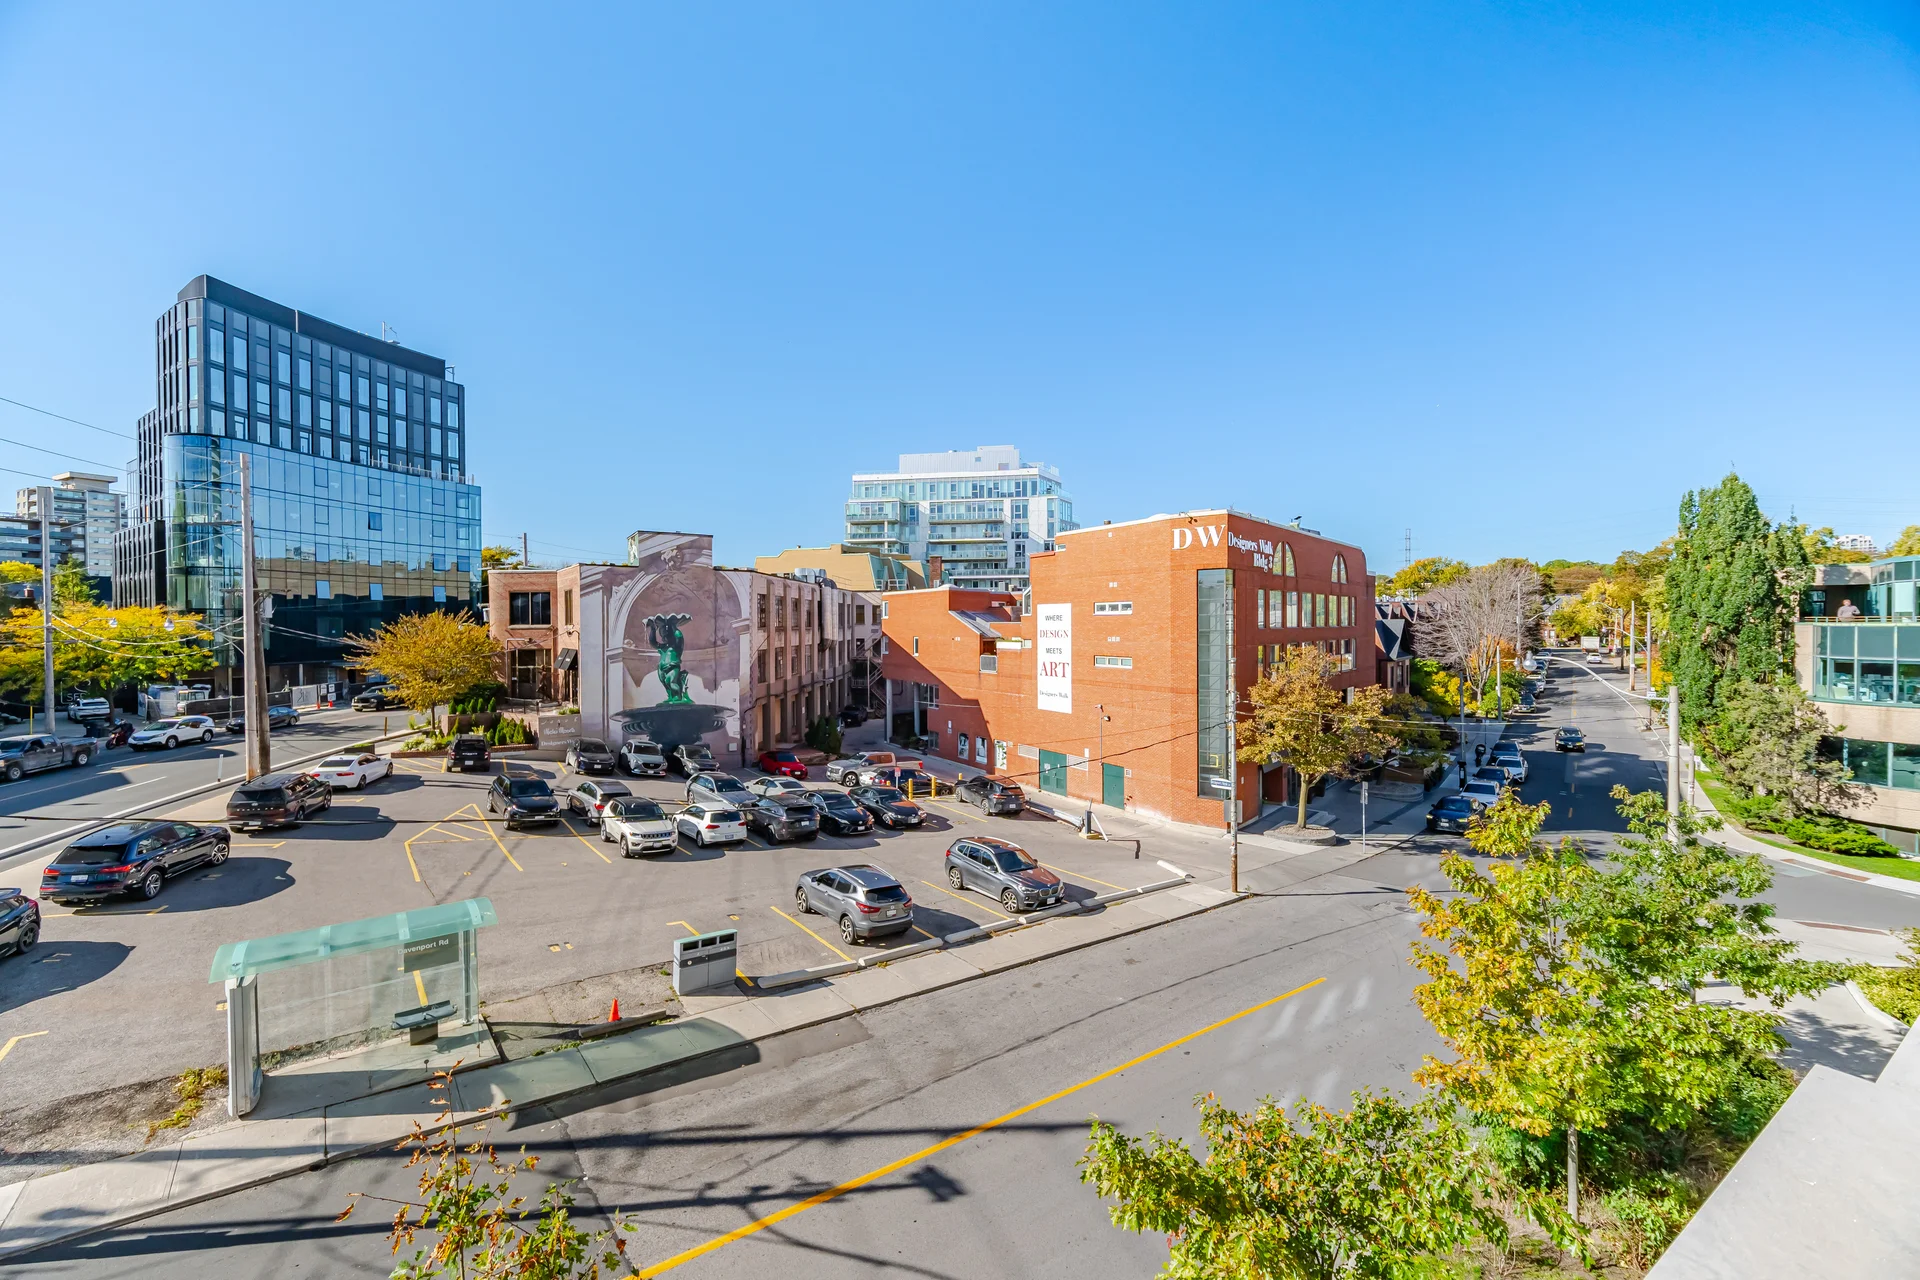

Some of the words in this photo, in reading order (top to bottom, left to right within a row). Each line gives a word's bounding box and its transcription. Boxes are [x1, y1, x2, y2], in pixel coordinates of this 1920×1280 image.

[1228, 532, 1258, 554] Designers
[1259, 539, 1273, 555] Walk
[1253, 552, 1268, 572] Bldg
[1268, 556, 1273, 569] 3
[1039, 629, 1069, 638] DESIGN
[1045, 647, 1063, 655] MEETS
[1040, 661, 1070, 678] ART
[398, 941, 437, 954] Davenport
